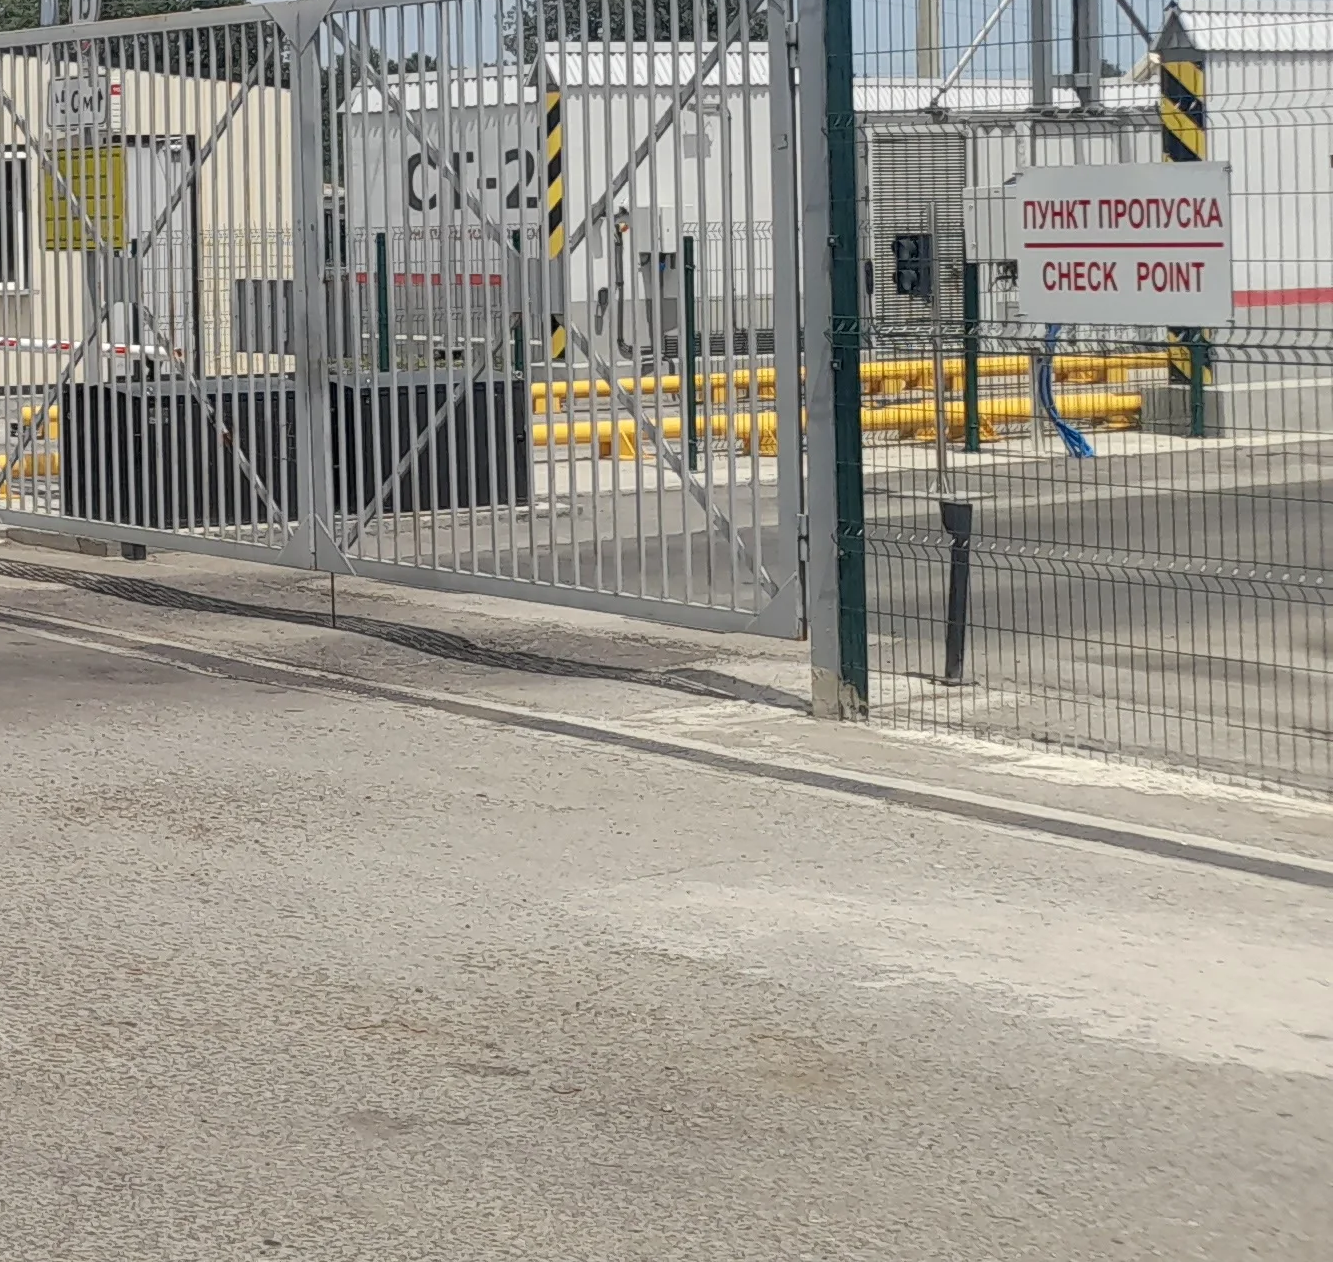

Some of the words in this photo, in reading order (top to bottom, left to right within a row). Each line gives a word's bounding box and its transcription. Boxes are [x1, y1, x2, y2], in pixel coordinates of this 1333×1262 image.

[1023, 199, 1091, 230] ПУНКТ
[1098, 197, 1224, 229] ПРОПУСКА
[1042, 261, 1118, 292] CHECK
[1136, 261, 1206, 293] POINT
